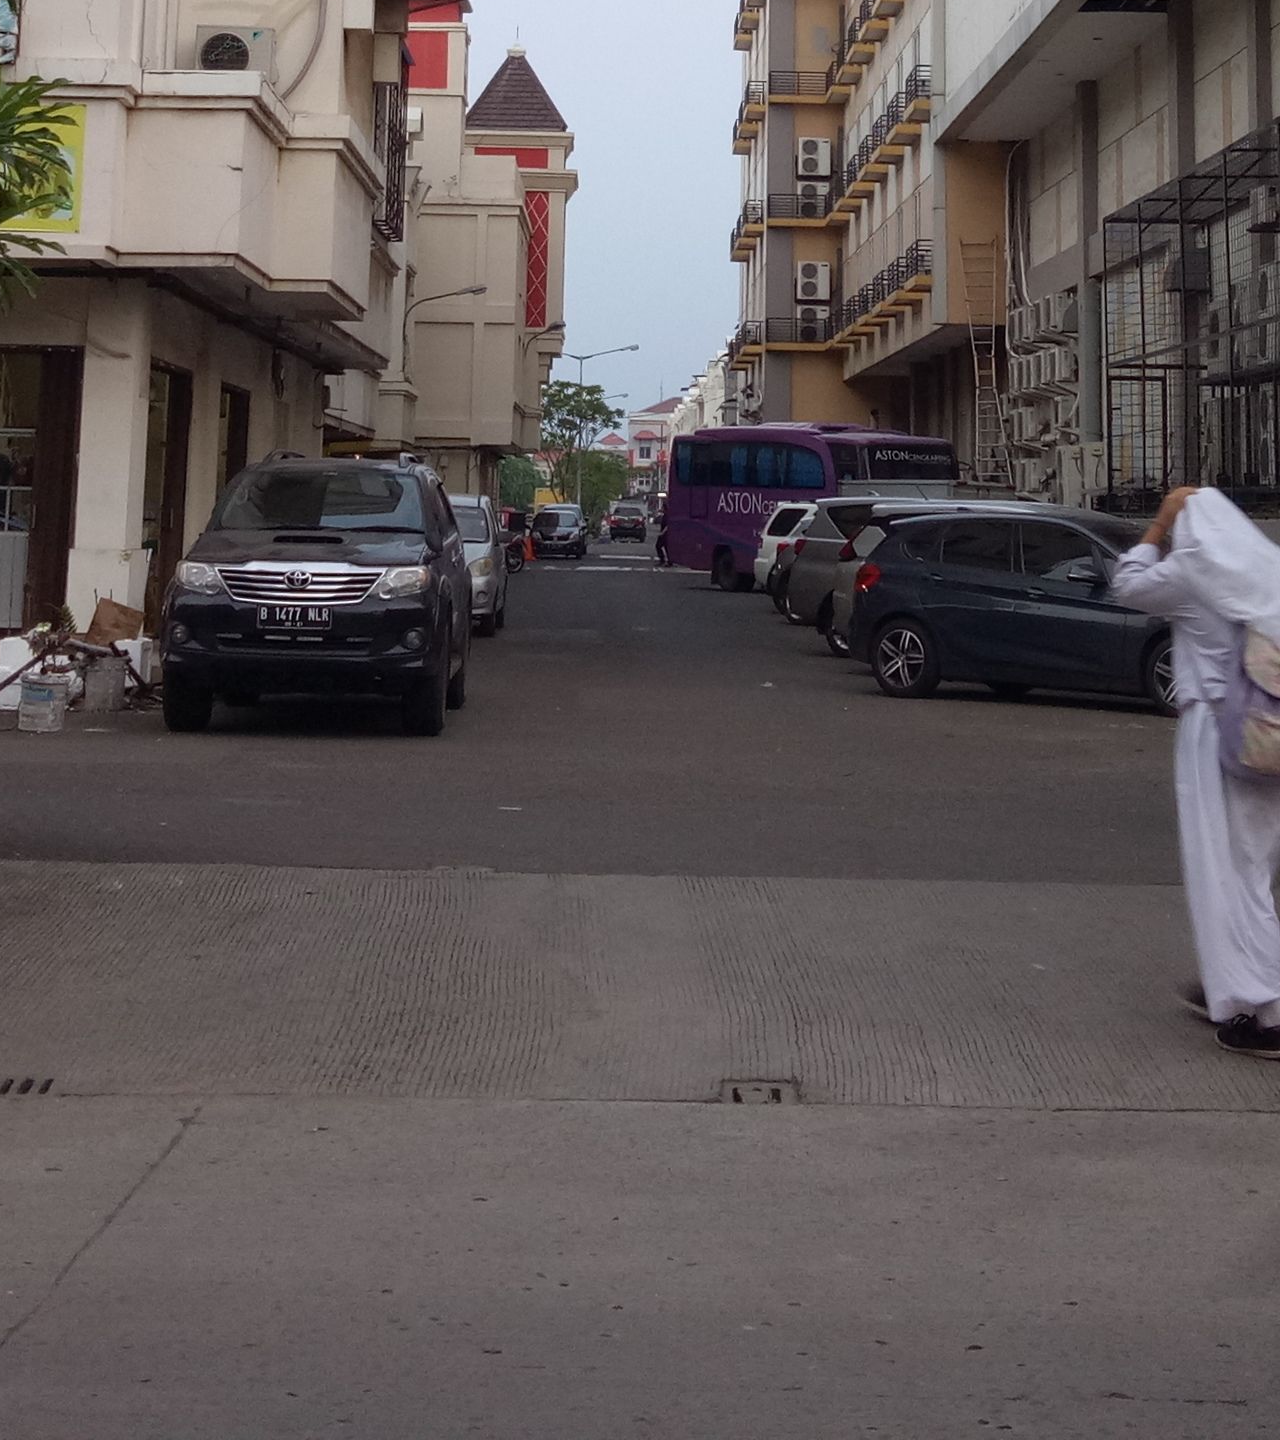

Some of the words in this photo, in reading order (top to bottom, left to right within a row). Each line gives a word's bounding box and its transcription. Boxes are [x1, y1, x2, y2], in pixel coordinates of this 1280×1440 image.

[875, 450, 908, 460] ASTON
[717, 492, 761, 514] ASTON
[260, 607, 268, 620] B
[275, 607, 302, 621] 1477
[308, 608, 329, 621] NLR
